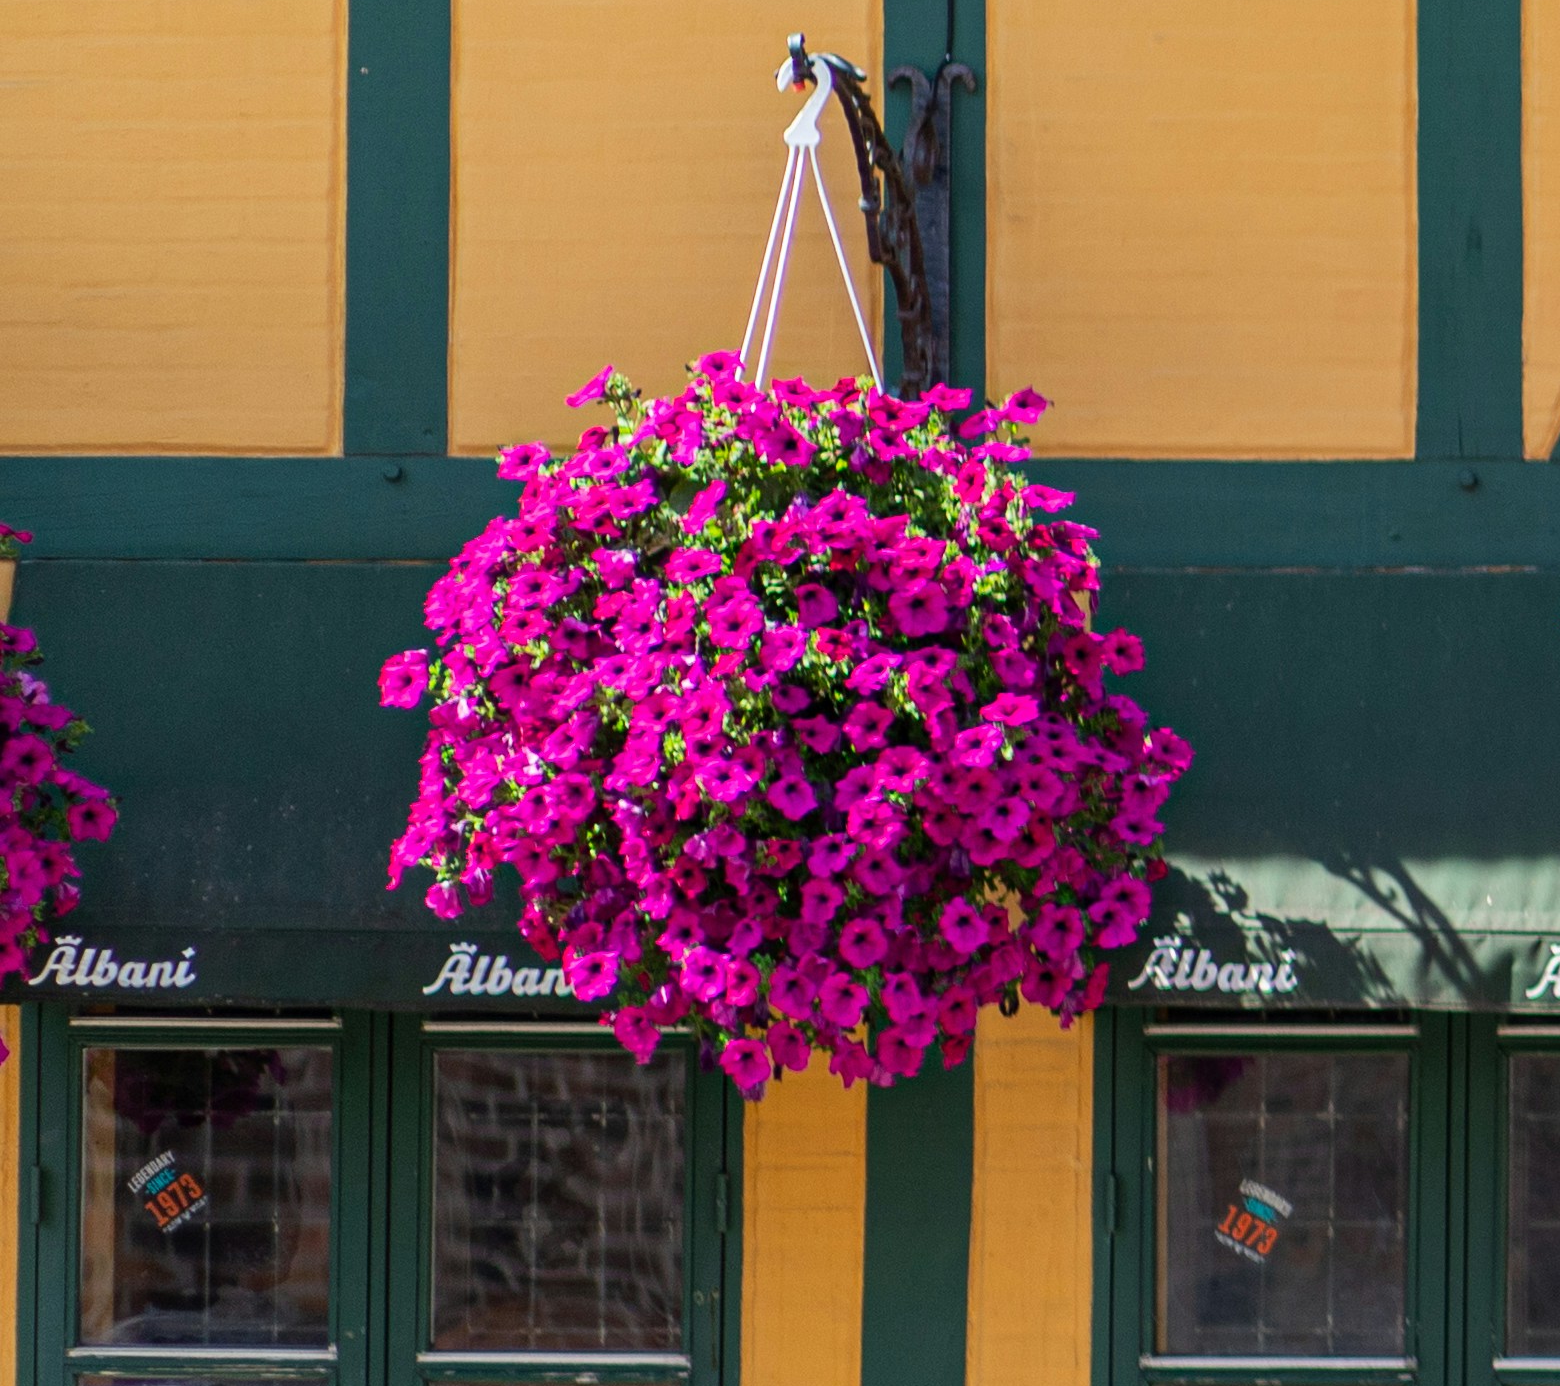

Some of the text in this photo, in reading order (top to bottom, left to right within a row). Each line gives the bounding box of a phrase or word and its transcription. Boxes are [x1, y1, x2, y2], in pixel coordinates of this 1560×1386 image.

[28, 934, 197, 989] Albani
[422, 941, 580, 996] Alban
[1127, 935, 1299, 993] Albani
[127, 1150, 176, 1194] LEGENDARY
[145, 1173, 203, 1226] 1973
[1218, 1205, 1278, 1255] 1973
